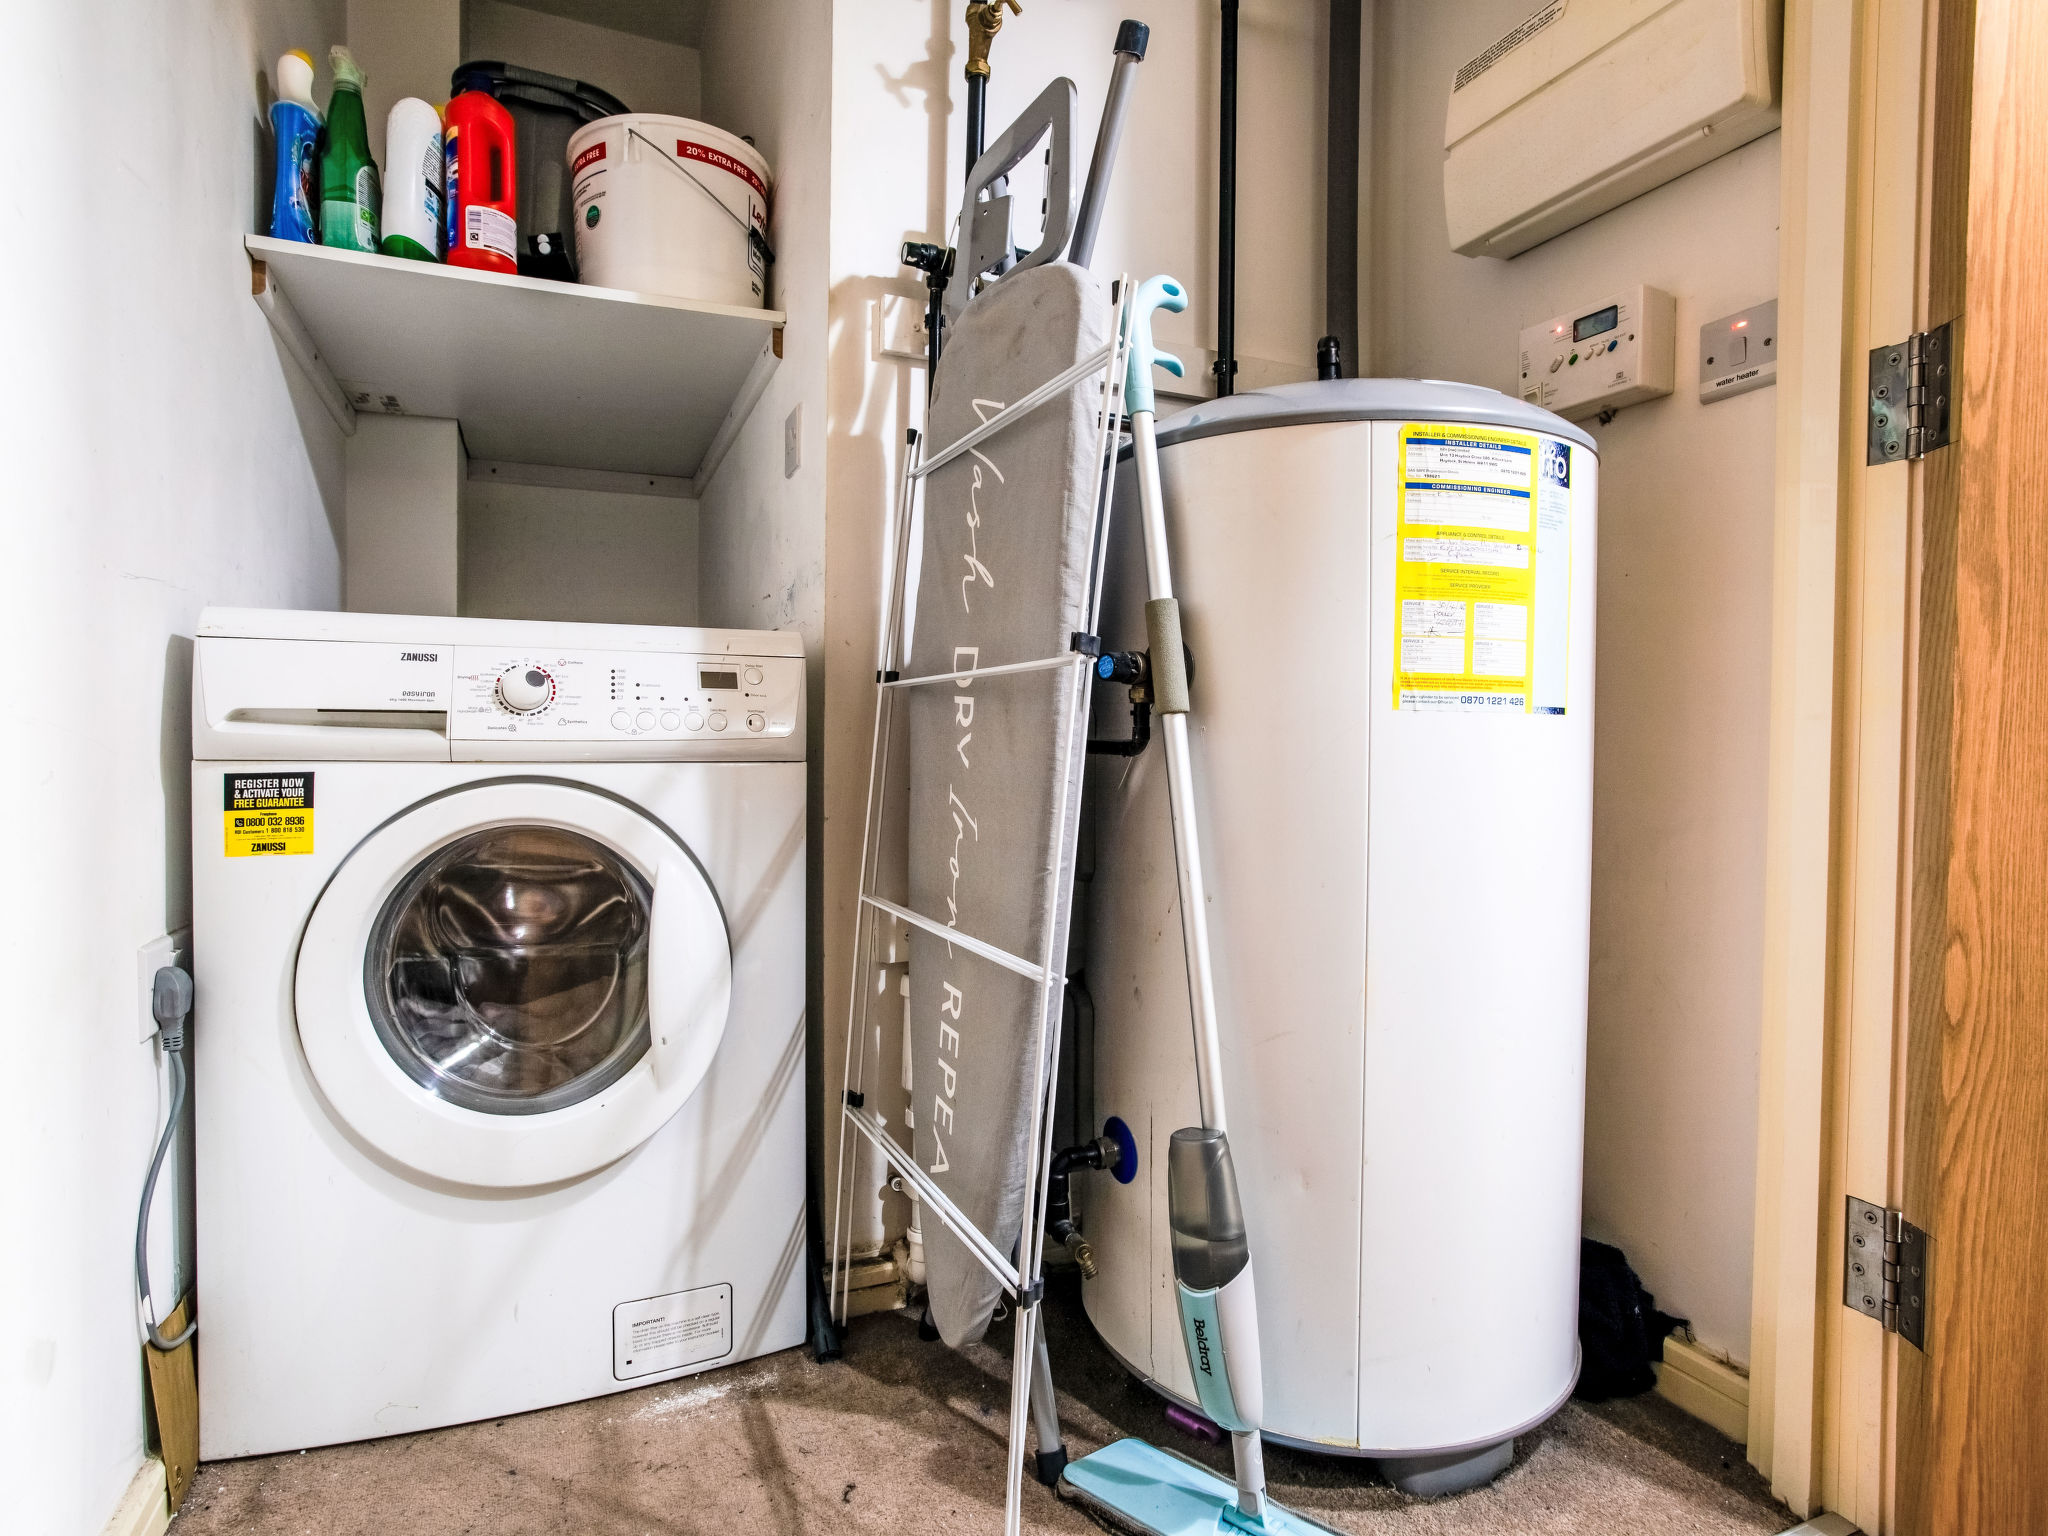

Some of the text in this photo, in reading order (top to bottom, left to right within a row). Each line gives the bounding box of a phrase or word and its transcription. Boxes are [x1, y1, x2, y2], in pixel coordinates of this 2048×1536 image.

[586, 148, 600, 161] FREE
[686, 146, 747, 177] 20% EXTRA FREE
[1716, 369, 1759, 387] water heater
[401, 652, 438, 662] ZANUSSI
[1461, 696, 1524, 706] 0870 1221 426
[235, 778, 304, 788] REGISTER NOW
[234, 788, 304, 798] & ACTIVATE YOUR
[234, 798, 304, 808] FREE GUARANTEE
[246, 816, 304, 826] 0800 032 8936
[251, 842, 285, 852] ZANUSSI
[632, 1317, 665, 1328] IMPORTANT!
[1193, 1317, 1212, 1376] Beldray
